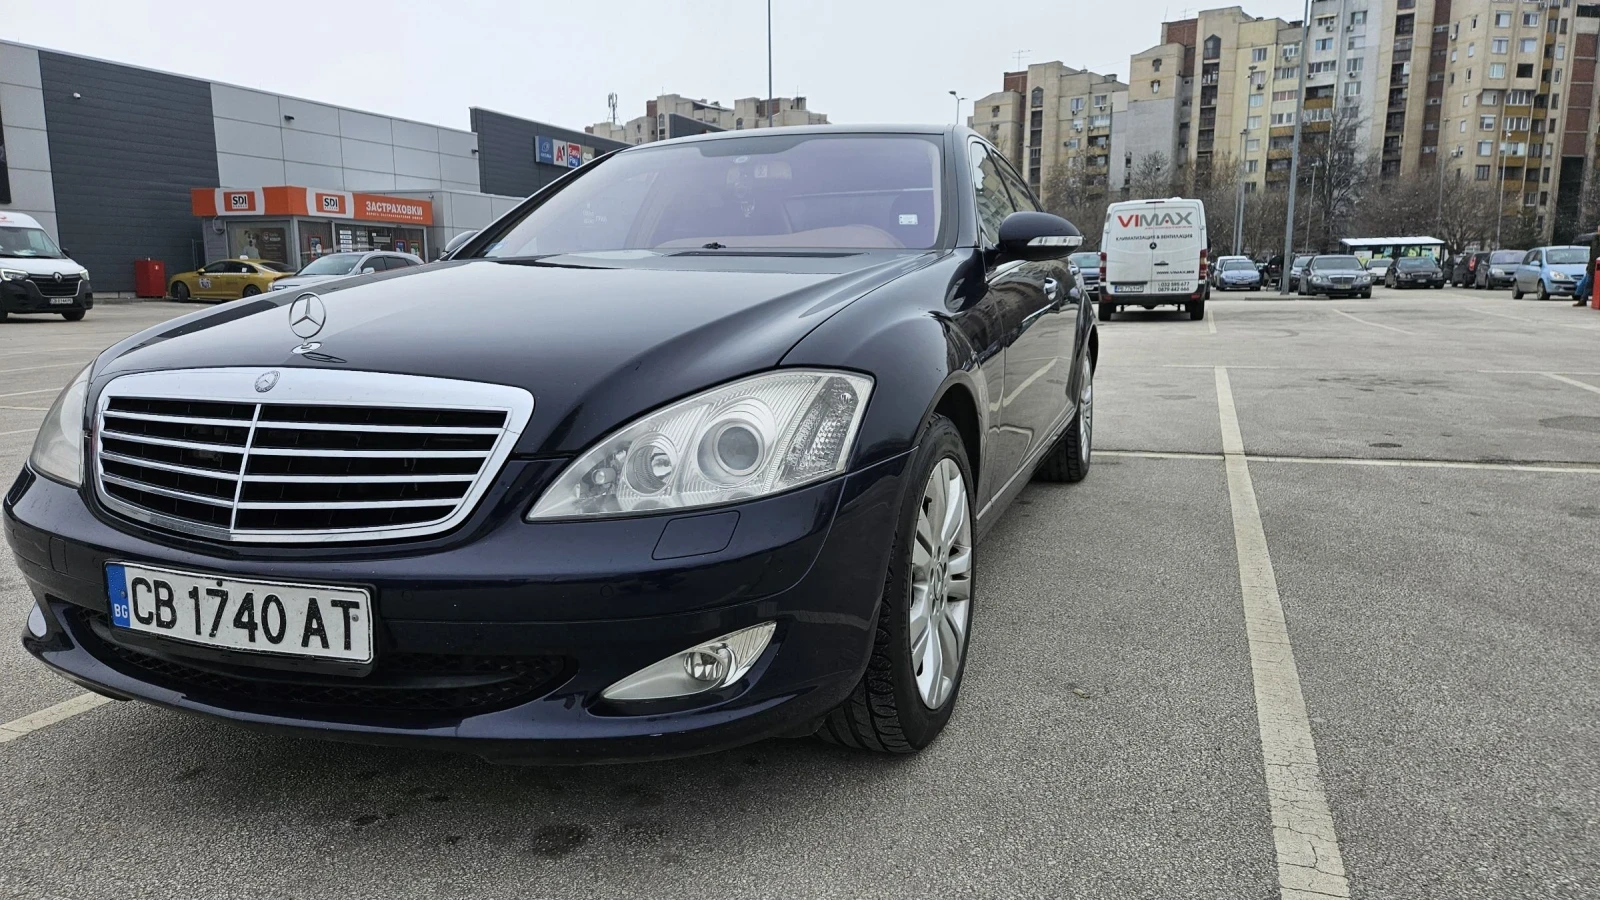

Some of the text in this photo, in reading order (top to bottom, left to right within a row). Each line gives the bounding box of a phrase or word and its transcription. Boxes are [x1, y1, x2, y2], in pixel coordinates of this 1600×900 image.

[556, 145, 565, 161] A1
[232, 196, 247, 205] SDI
[324, 197, 338, 207] SDI
[366, 201, 423, 216] ЗАСТРАХОВКИ
[1117, 212, 1193, 228] VIMAX
[114, 603, 128, 619] BG
[131, 577, 360, 651] CB 1740 AT
